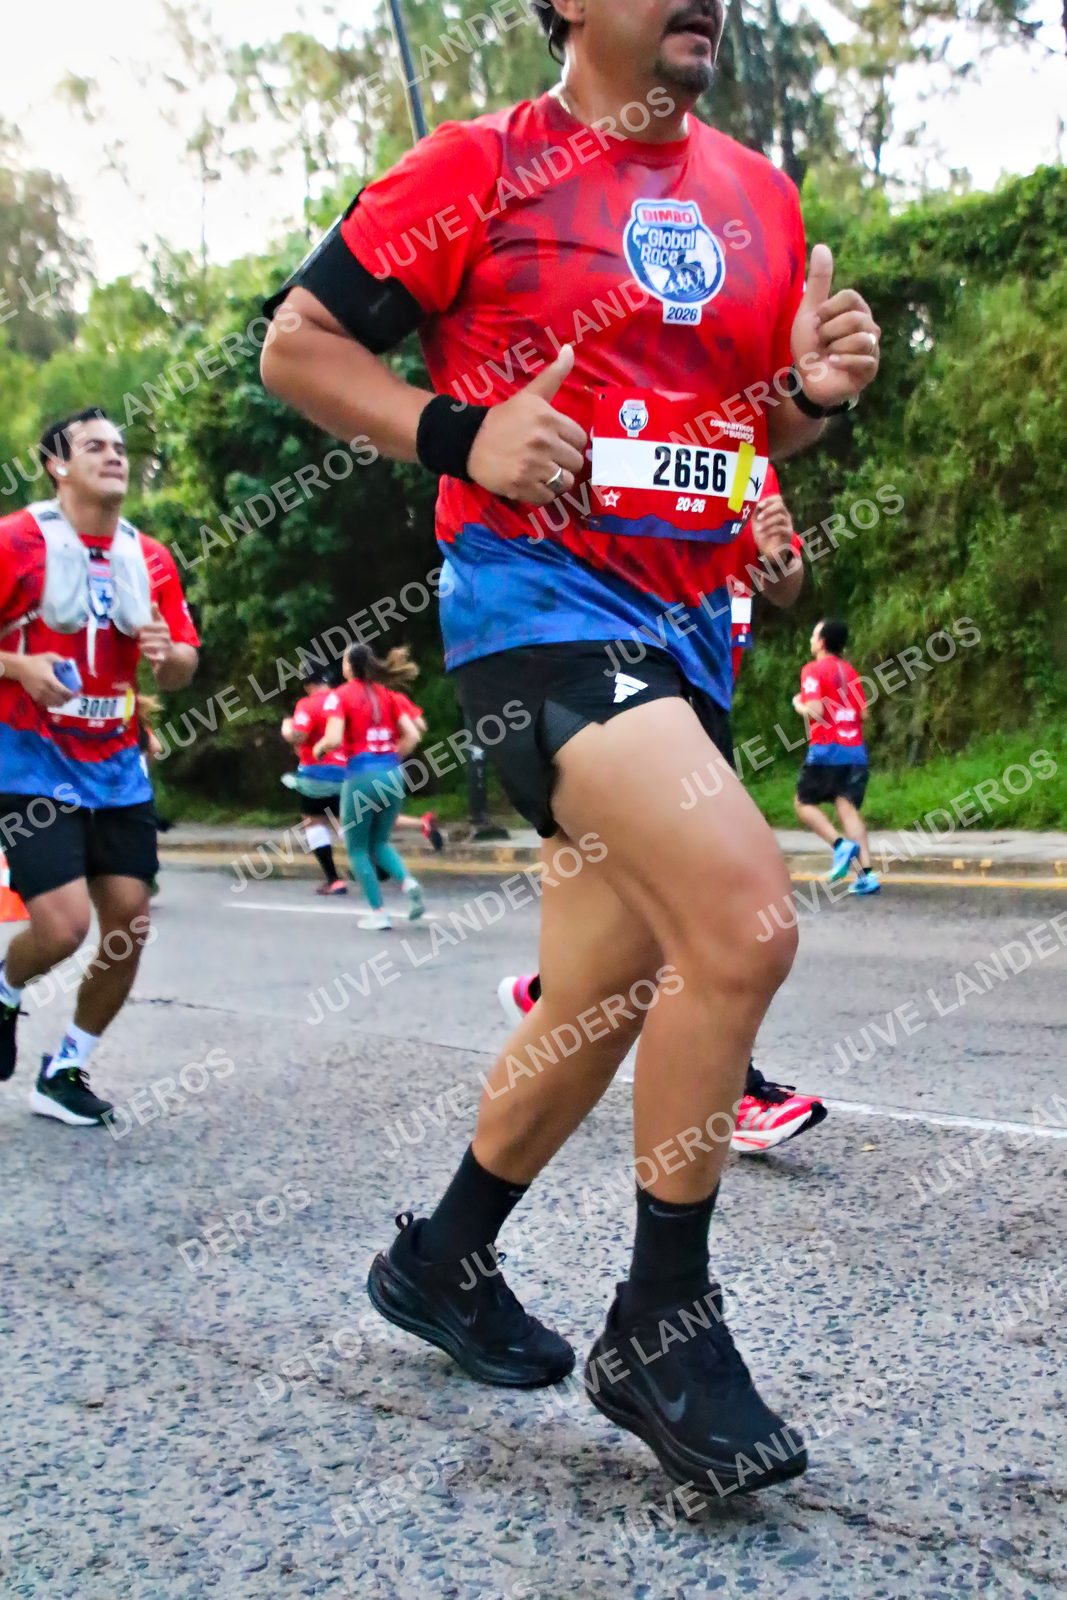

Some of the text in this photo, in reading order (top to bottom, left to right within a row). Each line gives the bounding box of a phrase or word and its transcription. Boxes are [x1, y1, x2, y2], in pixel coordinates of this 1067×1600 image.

[647, 228, 696, 250] Global
[640, 242, 679, 266] Race
[666, 306, 698, 321] 2026
[652, 445, 727, 493] 2656
